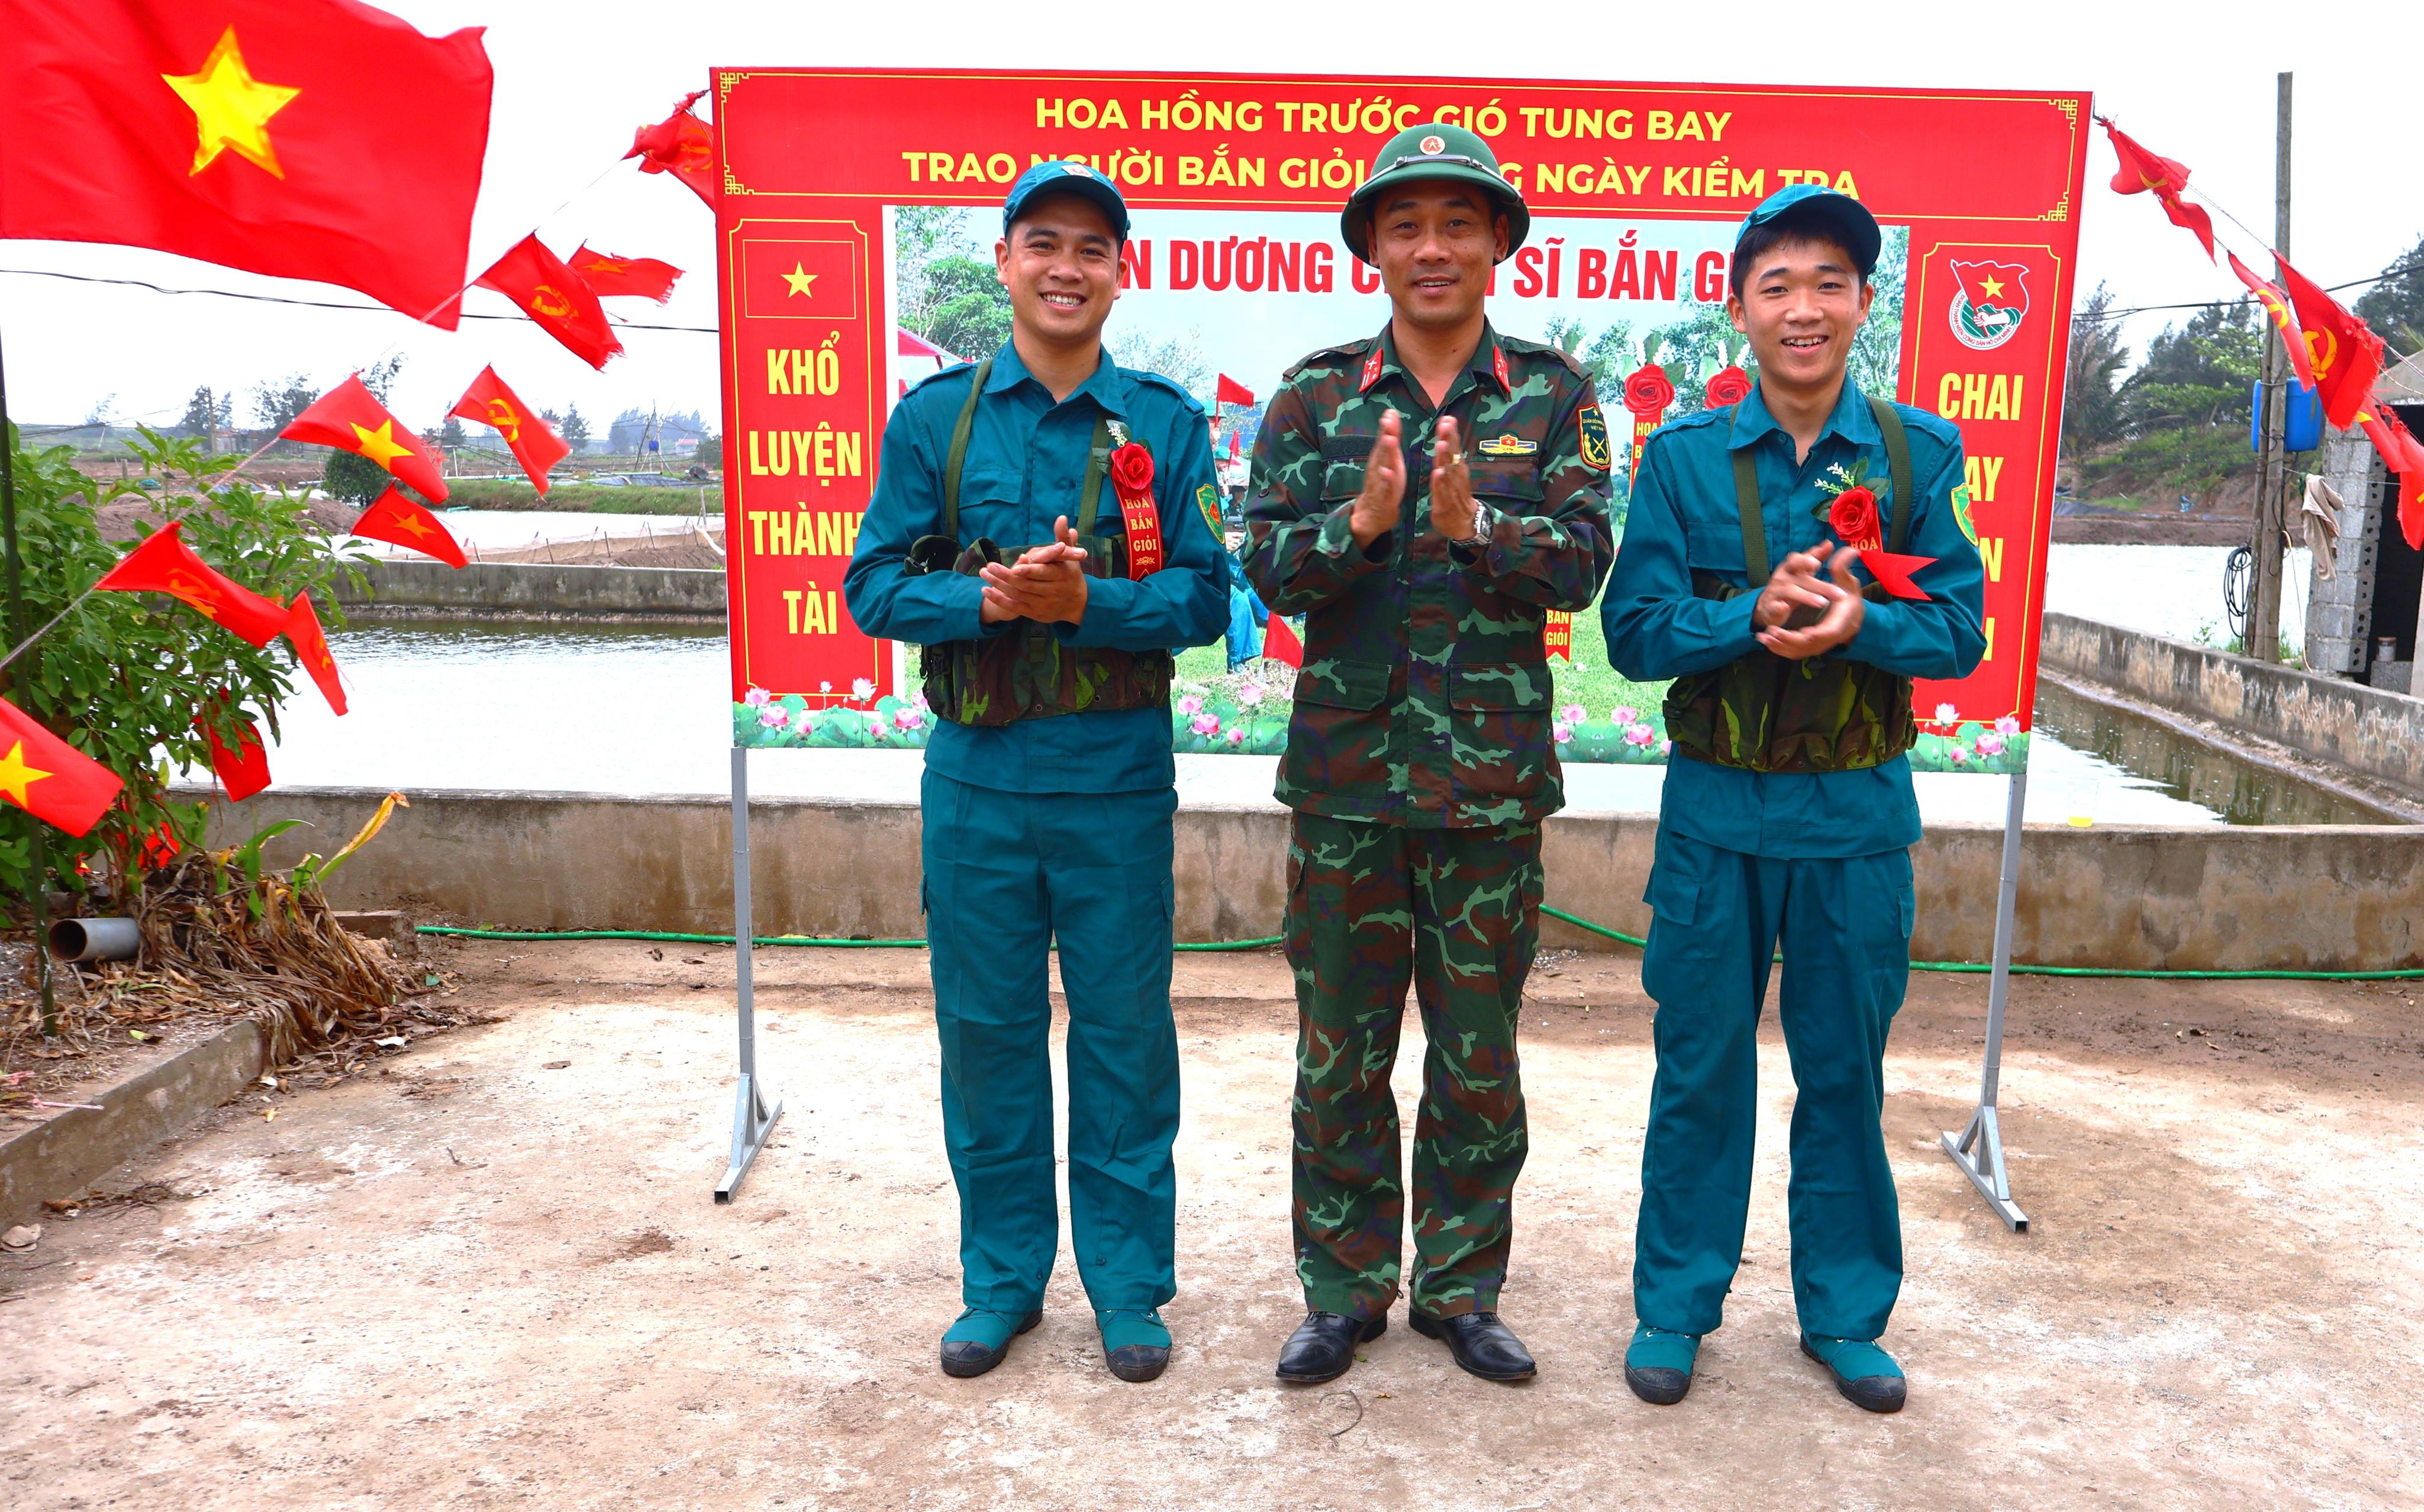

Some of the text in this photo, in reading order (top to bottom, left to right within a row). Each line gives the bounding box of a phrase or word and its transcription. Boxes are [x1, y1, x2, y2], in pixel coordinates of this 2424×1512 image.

[1036, 89, 1732, 141] HOA HỒNG TRƯỚC GIÓ TUNG BAY
[902, 152, 1017, 183] TRAO
[1178, 143, 1265, 186] BẮN
[1279, 147, 1365, 189] GIỎI
[1536, 157, 1652, 195] NGÀY
[1663, 156, 1765, 198] KIỂM
[1170, 236, 1333, 294] DƯƠNG
[1513, 237, 1565, 298] SĨ
[1578, 230, 1678, 301] BẮN
[767, 331, 840, 396] KHỔ
[1938, 372, 2024, 421] CHAI
[749, 421, 862, 486] LUYỆN
[1964, 456, 2004, 502] AY
[749, 501, 865, 556] THÀNH
[1124, 498, 1150, 510] HOA
[1133, 534, 1158, 552] GIỎI
[1851, 536, 1879, 551] HOA
[782, 581, 837, 635] TÀI
[1546, 627, 1568, 646] GIỎI
